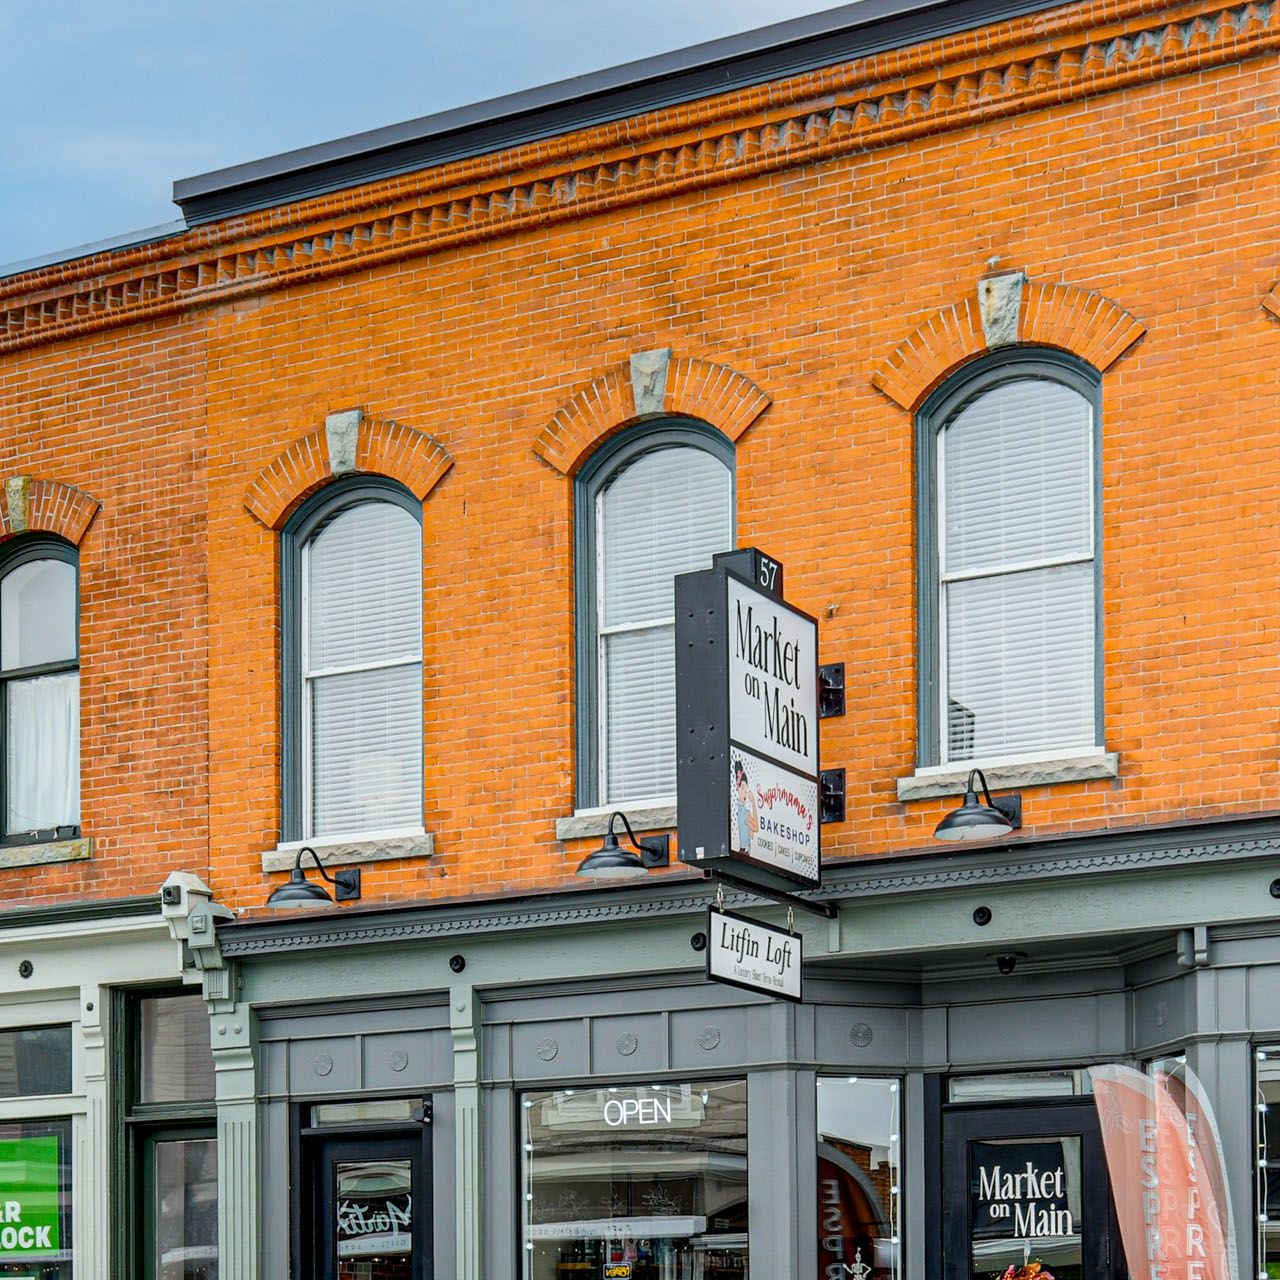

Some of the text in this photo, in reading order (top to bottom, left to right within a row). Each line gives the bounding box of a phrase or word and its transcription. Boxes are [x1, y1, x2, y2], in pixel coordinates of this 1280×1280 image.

[760, 558, 777, 590] 57
[736, 600, 801, 690] Market
[745, 673, 760, 700] on
[764, 681, 808, 757] Main
[757, 784, 814, 831] Sugarmama's
[757, 837, 773, 851] COOKIES
[778, 845, 790, 857] CAKES
[760, 816, 811, 847] BAKESHOP
[720, 922, 792, 975] Litfin Loft
[604, 1098, 671, 1126] OPEN
[979, 1162, 1064, 1200] Market
[990, 1202, 1074, 1237] on Main
